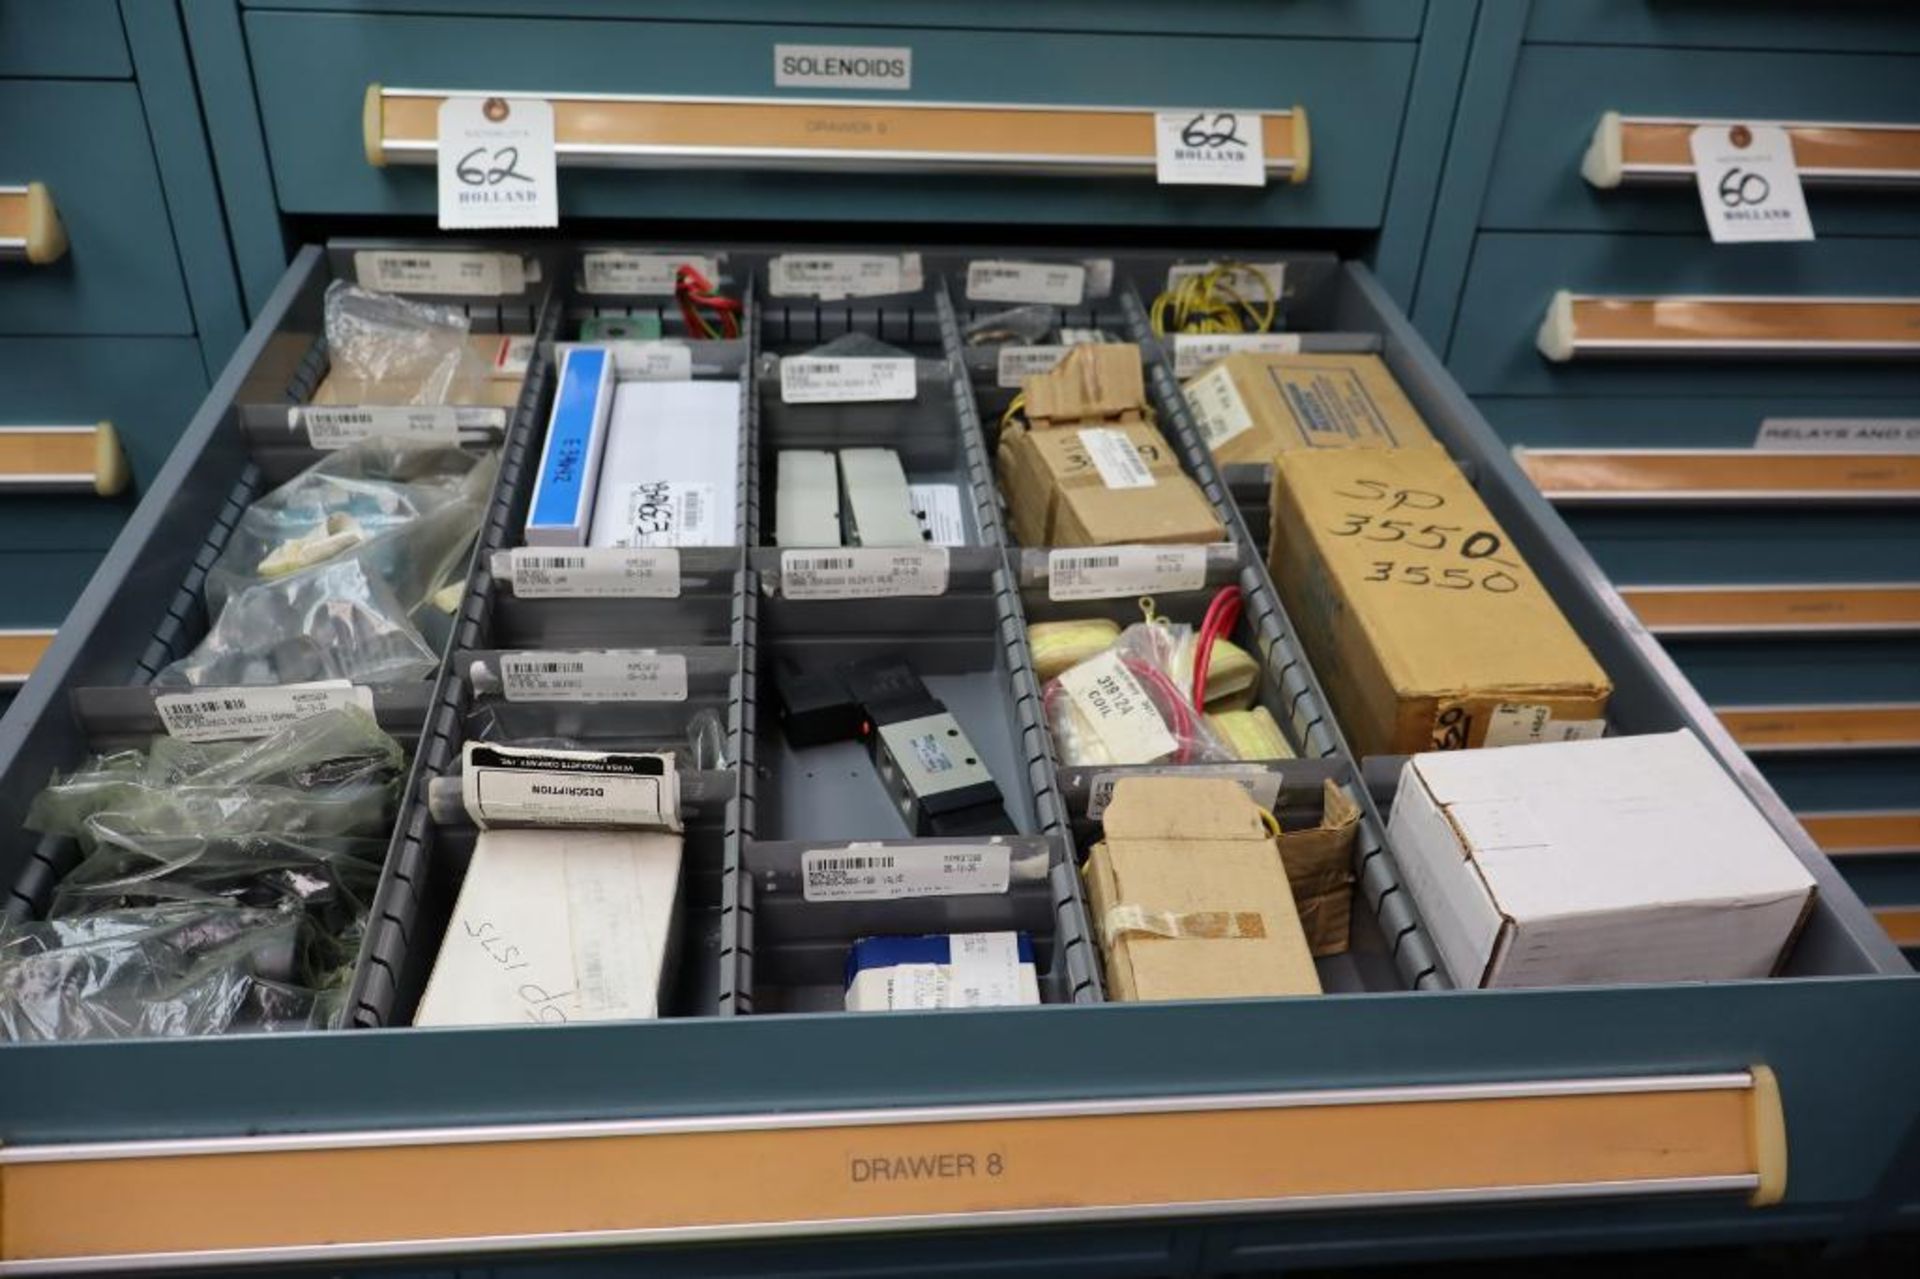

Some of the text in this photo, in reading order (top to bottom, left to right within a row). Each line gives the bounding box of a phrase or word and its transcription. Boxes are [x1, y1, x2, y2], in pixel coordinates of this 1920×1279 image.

[782, 56, 905, 77] SOLENOIDS
[1181, 113, 1248, 148] 62
[456, 146, 535, 186] 62
[1174, 149, 1246, 162] HOLLAND
[458, 190, 537, 204] HOLLAND
[1718, 167, 1770, 208] 60
[1723, 208, 1791, 221] HOLLAND
[1766, 428, 1847, 439] RELAYS
[1328, 513, 1501, 559] 3550
[1364, 561, 1519, 593] 3550
[1087, 690, 1115, 719] COIL
[560, 761, 605, 771] PRODUCTS
[531, 785, 604, 797] DESCRIPTION
[852, 1153, 1004, 1182] DRAWER 8
